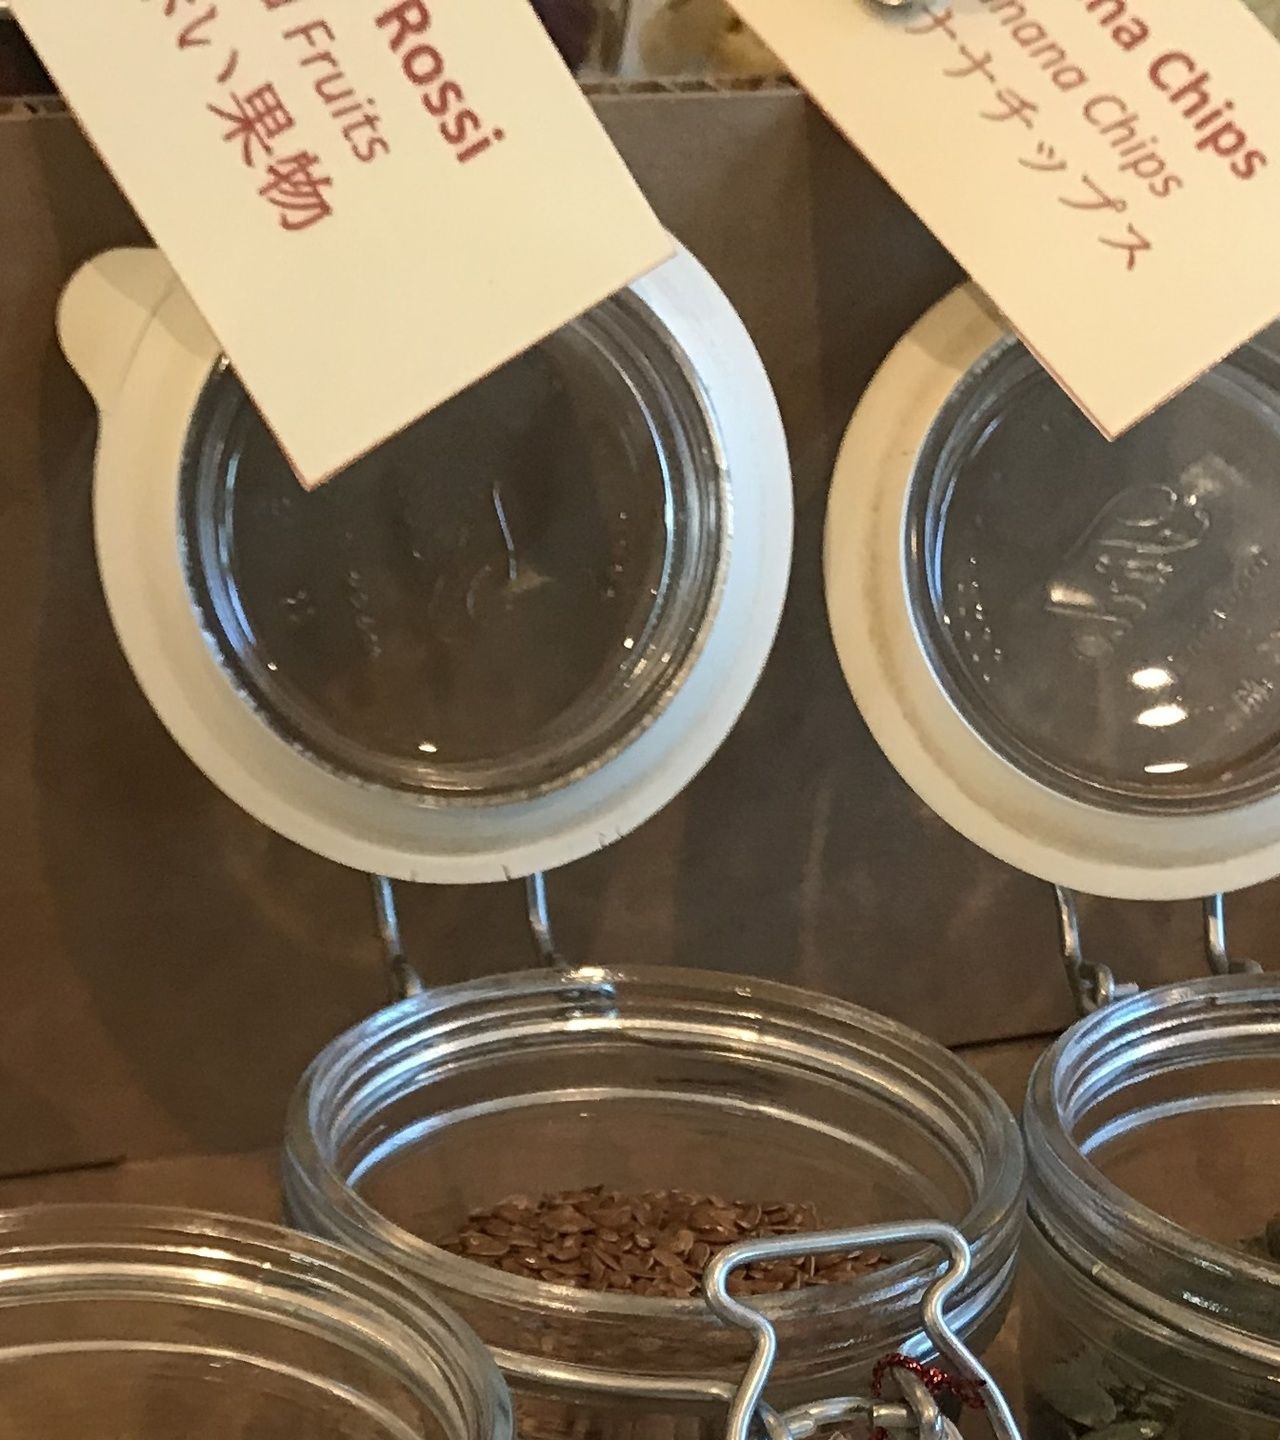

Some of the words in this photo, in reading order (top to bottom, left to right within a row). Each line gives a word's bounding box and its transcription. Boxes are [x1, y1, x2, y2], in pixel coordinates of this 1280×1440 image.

[283, 19, 390, 163] Fruits
[375, 0, 505, 164] Rossi
[1083, 95, 1183, 198] Chips
[1148, 51, 1268, 181] Chips
